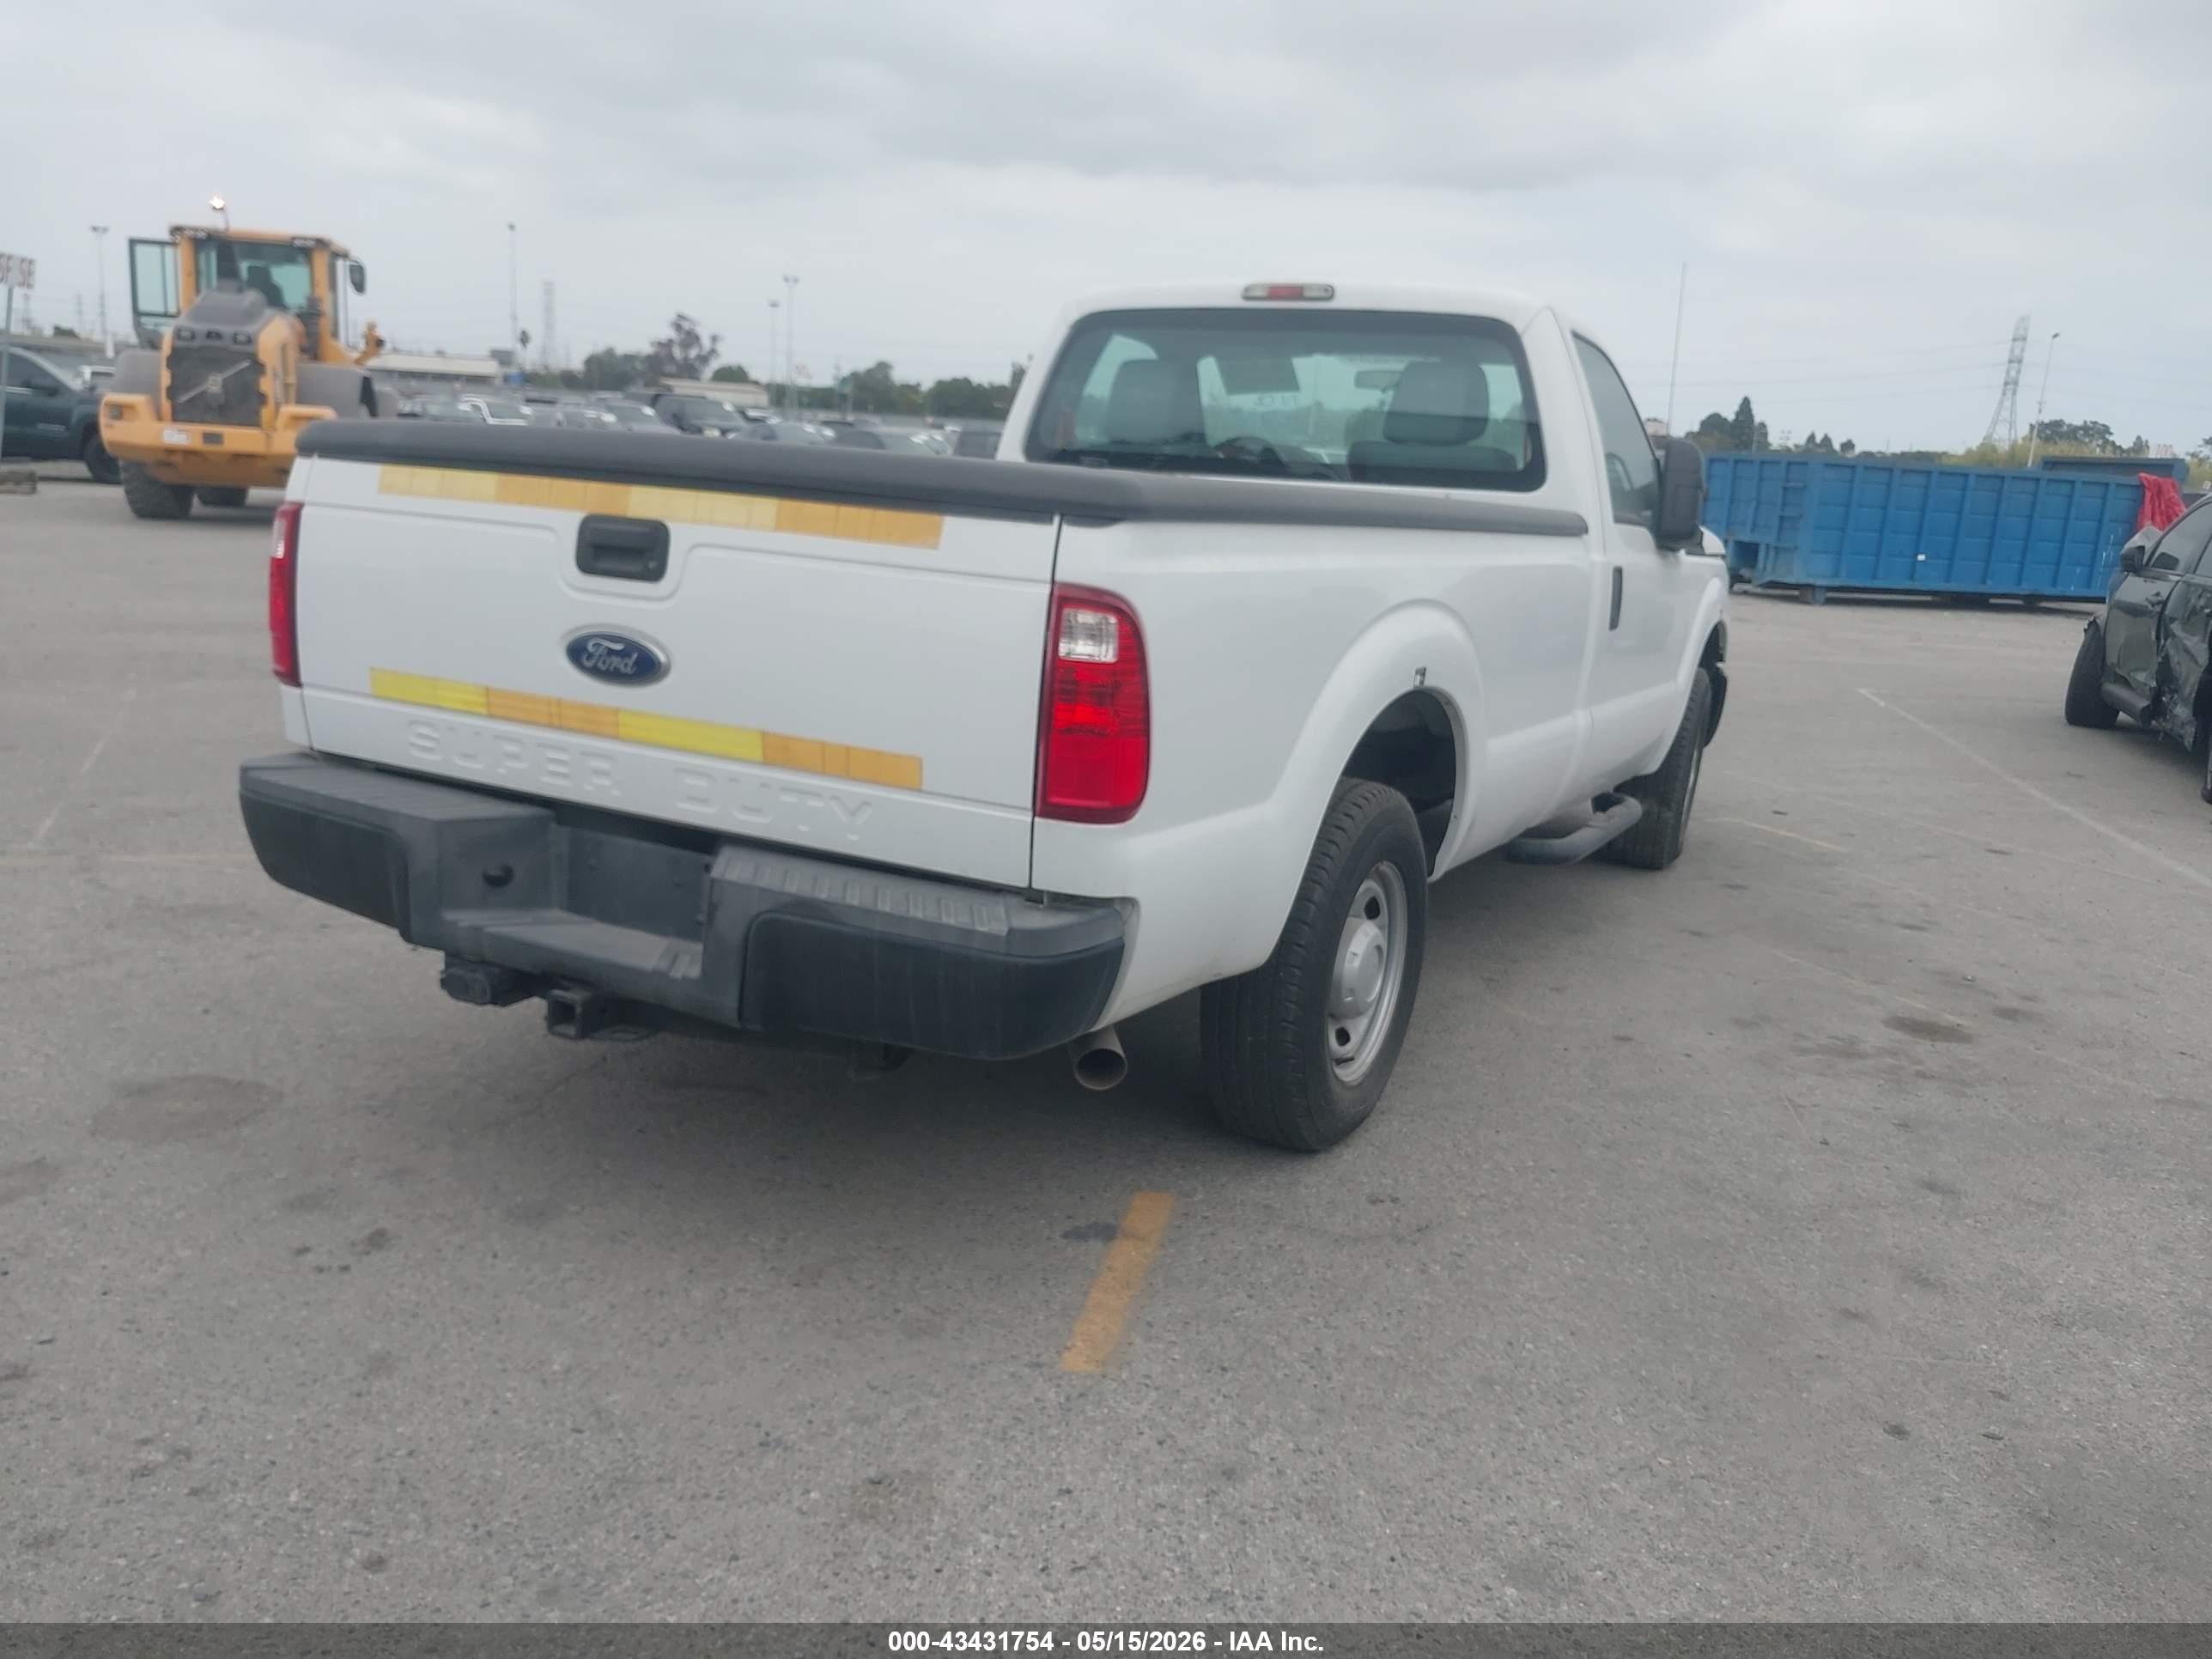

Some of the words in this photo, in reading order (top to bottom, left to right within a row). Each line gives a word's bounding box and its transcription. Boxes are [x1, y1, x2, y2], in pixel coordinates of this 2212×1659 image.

[582, 637, 638, 674] Ford
[407, 719, 623, 797] SUPER
[673, 766, 873, 841] DUTY
